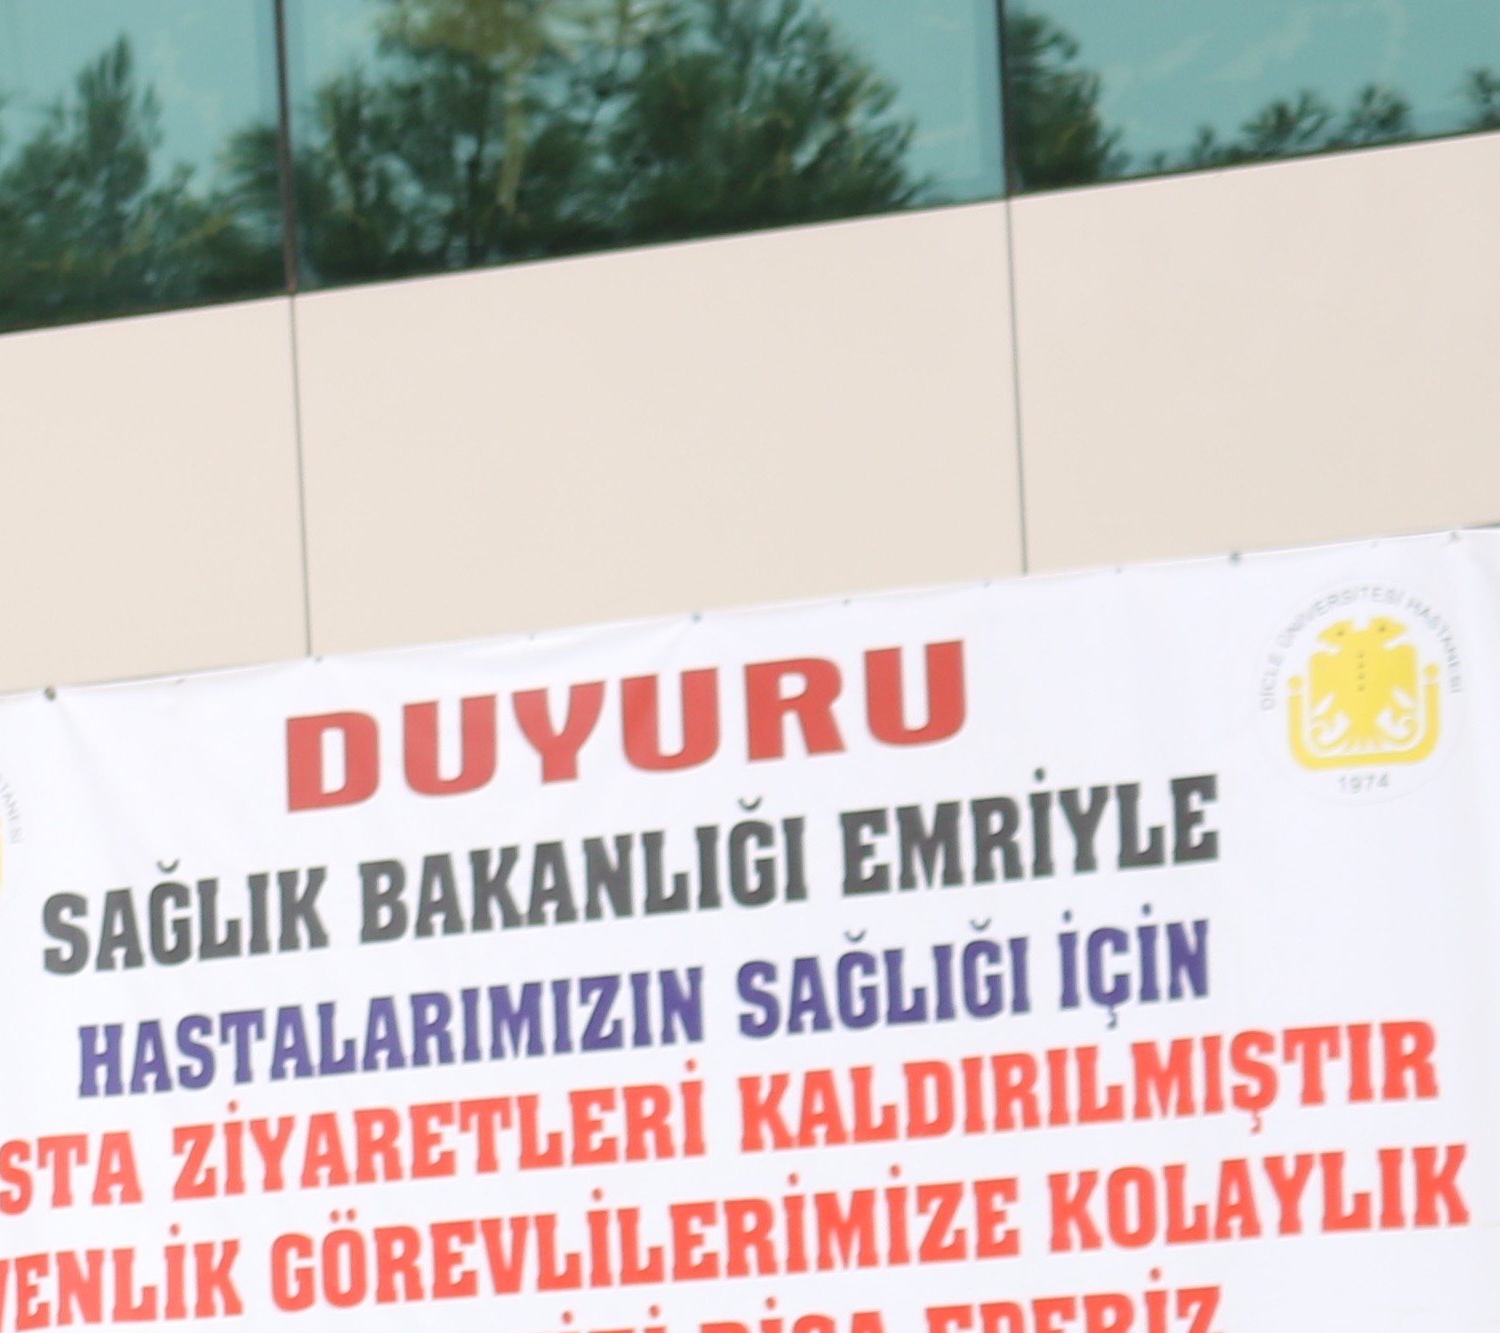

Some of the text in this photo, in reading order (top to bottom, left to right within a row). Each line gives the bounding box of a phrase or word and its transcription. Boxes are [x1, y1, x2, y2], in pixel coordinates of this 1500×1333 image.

[286, 639, 966, 812] DUYURU
[1338, 773, 1390, 794] 1974
[42, 768, 1218, 975] SAĞLIK BAKANLIĞI EMRİYLE
[78, 903, 1208, 1100] HASTALARIMIZIN SAĞLIĞI İÇİN
[173, 1059, 705, 1200] ZİYARETLERİ
[738, 1020, 1438, 1152] KALDIRILMIŞTIR
[271, 1164, 1019, 1312] GÖREVLİLERİMİZE
[1048, 1143, 1469, 1252] KOLAYLIK
